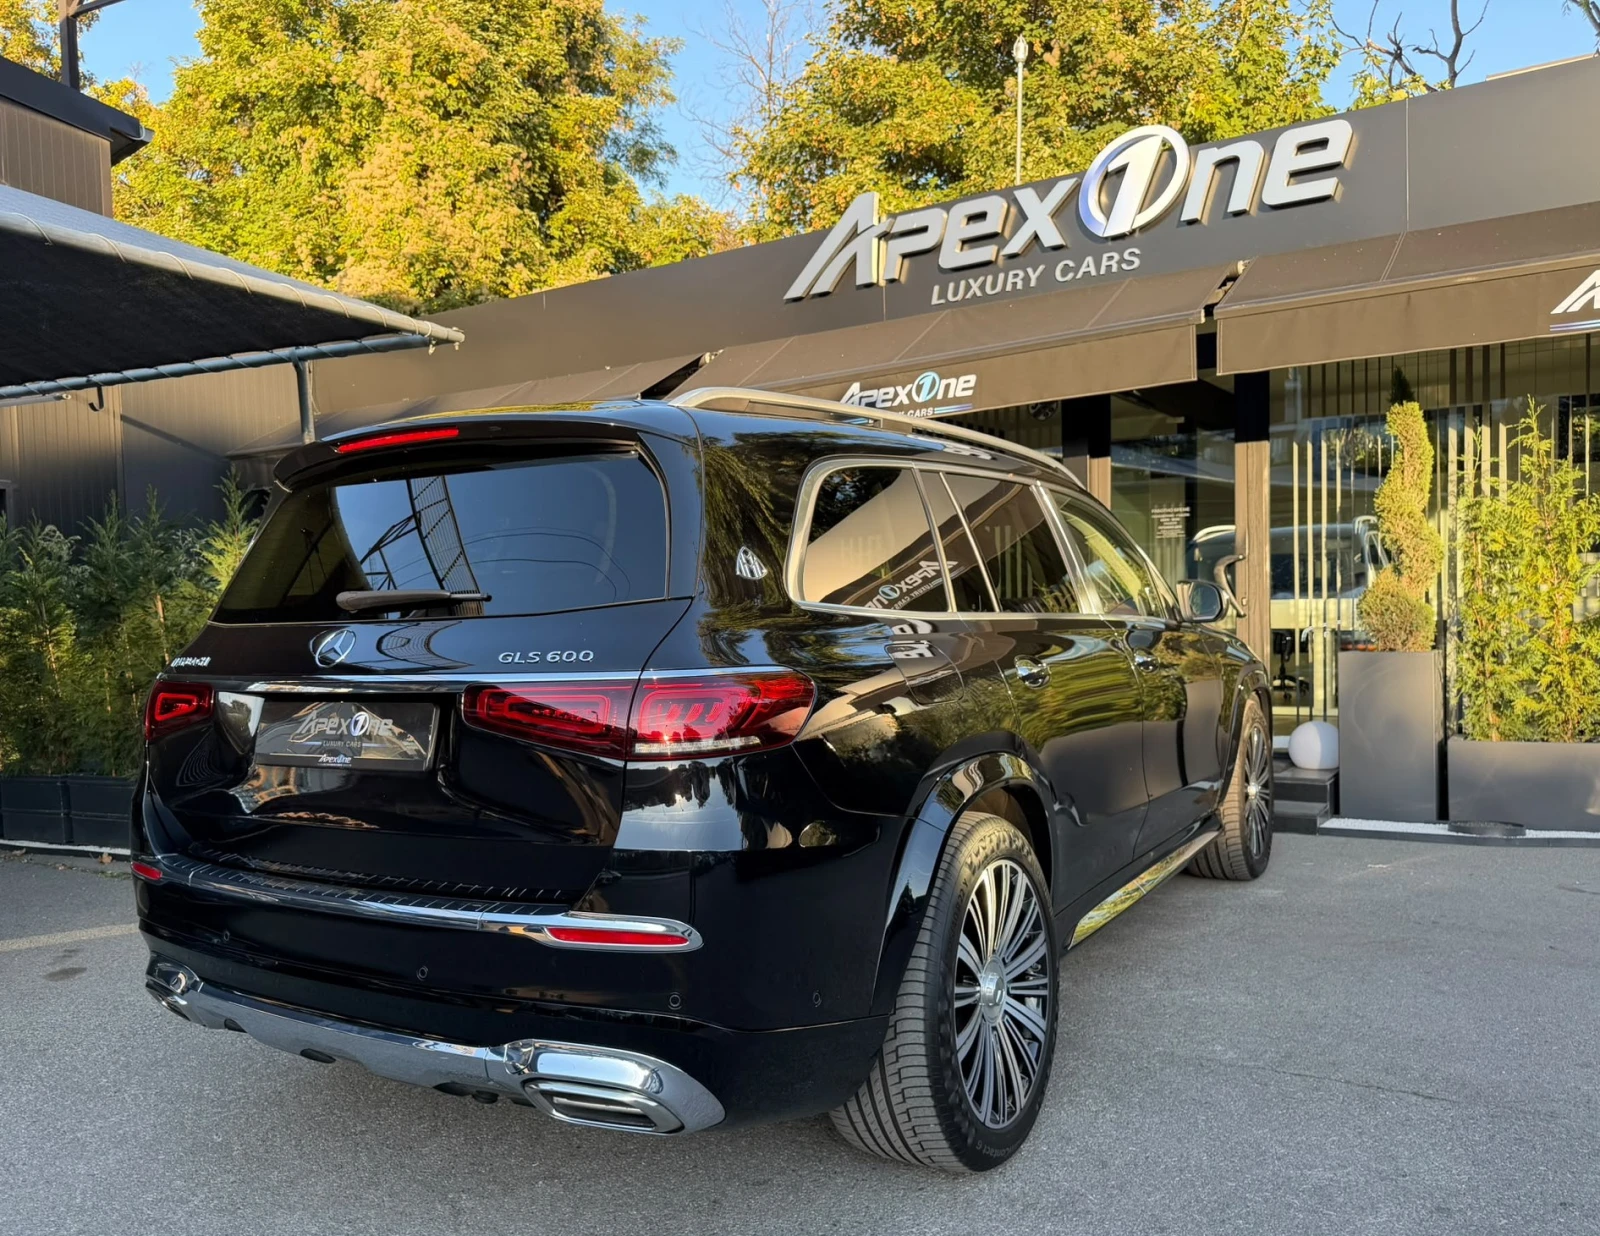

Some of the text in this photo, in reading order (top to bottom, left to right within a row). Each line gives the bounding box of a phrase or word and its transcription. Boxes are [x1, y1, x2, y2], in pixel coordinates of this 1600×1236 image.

[931, 247, 1142, 305] LUXURY CARS
[908, 407, 934, 418] CARS
[498, 650, 594, 664] GLS 600
[345, 740, 362, 748] CARS
